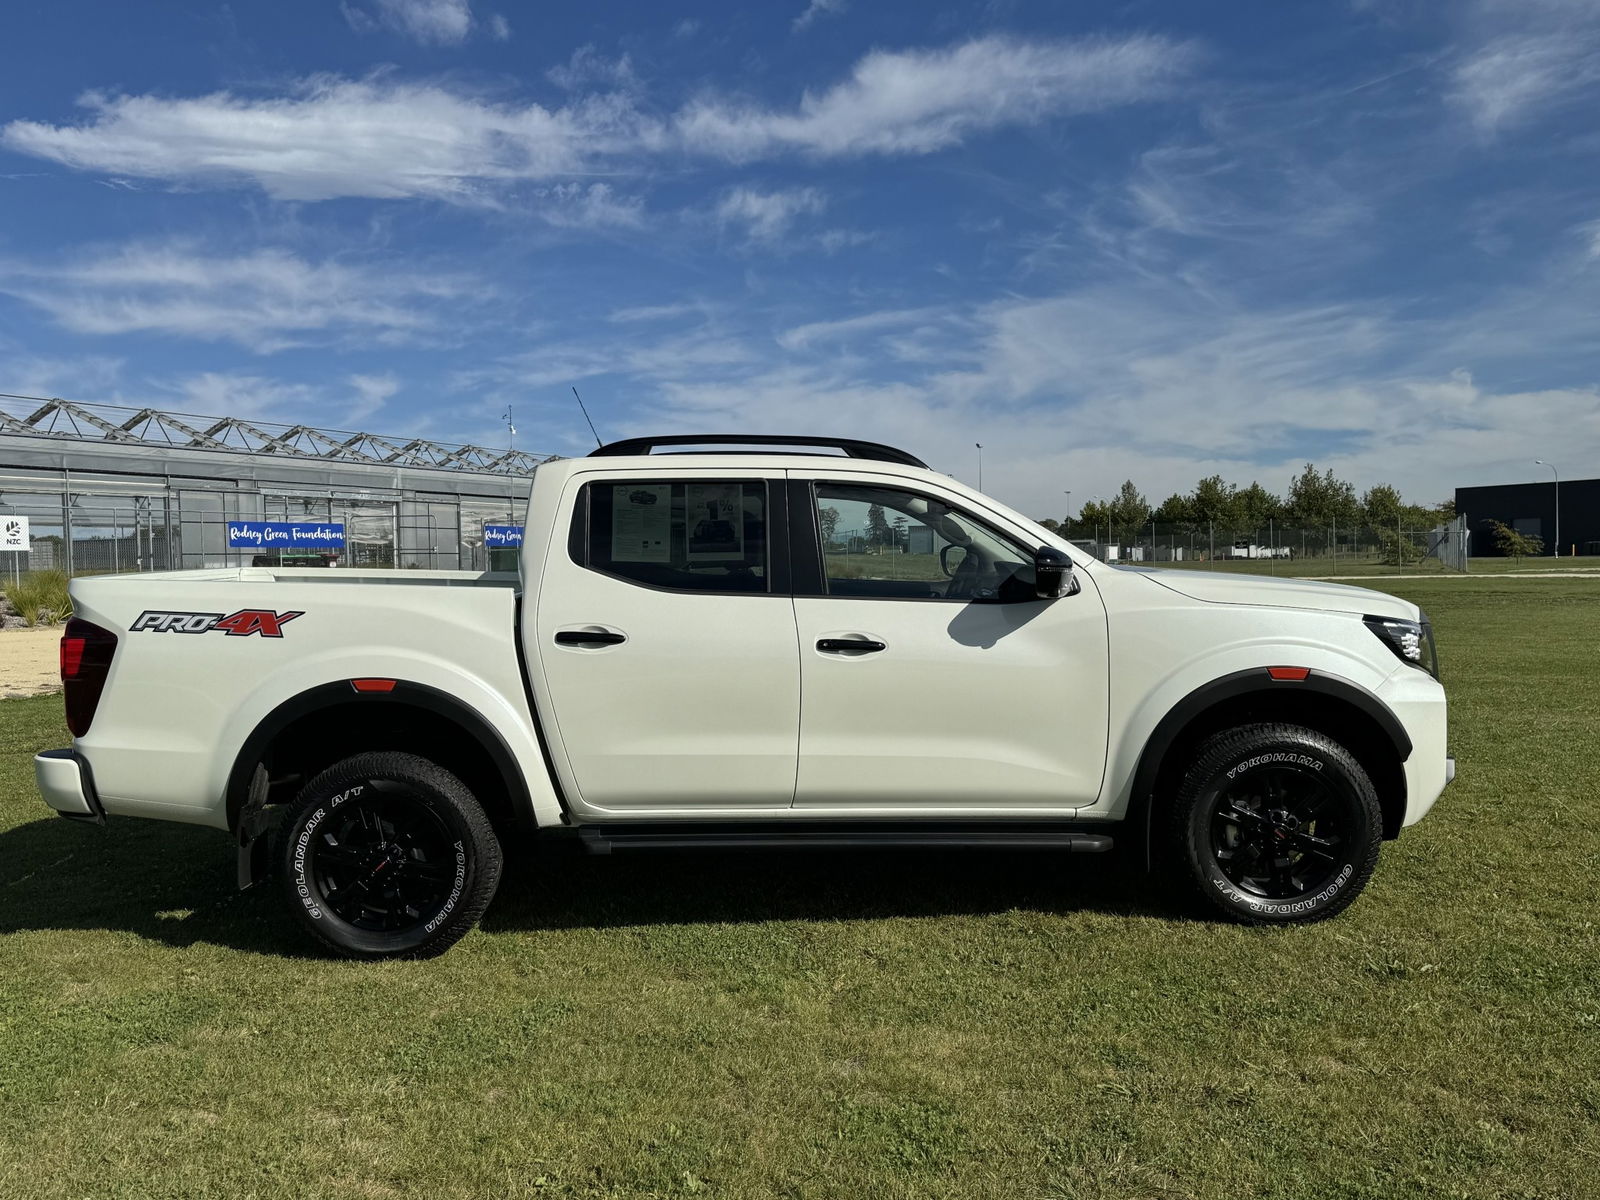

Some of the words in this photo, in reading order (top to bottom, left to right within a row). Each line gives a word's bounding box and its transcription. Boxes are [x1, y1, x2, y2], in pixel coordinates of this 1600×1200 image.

[230, 525, 263, 545] Rodney
[264, 527, 289, 541] Green
[292, 527, 343, 541] Foundation
[485, 528, 506, 544] Rodney
[129, 609, 305, 638] PRO-4X
[1226, 752, 1324, 779] YOKOHAMA
[294, 808, 326, 919] GEOLANDAR
[331, 785, 364, 807] A/T
[425, 840, 466, 933] YOKOHAMA
[1213, 878, 1243, 902] A/T
[1250, 864, 1353, 914] GEOLANDAR
